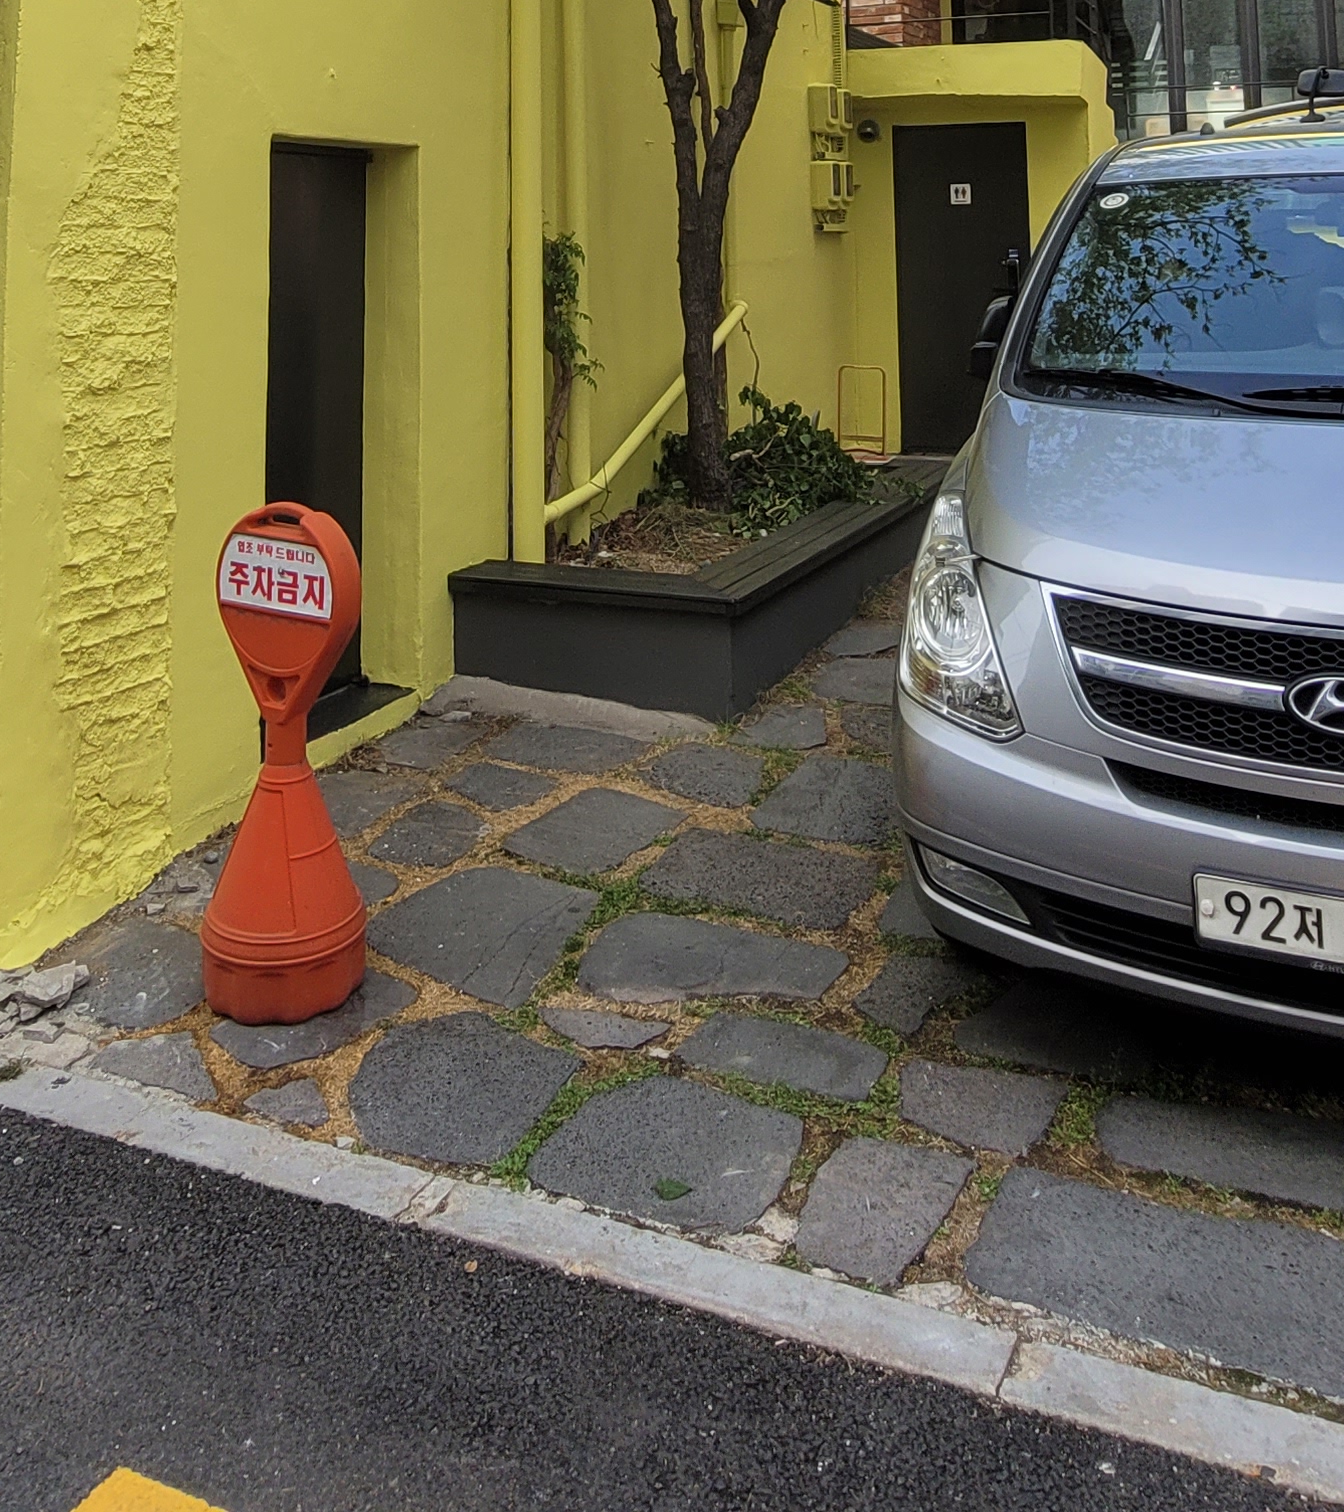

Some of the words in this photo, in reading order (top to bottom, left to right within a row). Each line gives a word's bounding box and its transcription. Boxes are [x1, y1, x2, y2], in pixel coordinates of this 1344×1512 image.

[257, 543, 273, 557] 부탁
[275, 547, 316, 565] 드립니다
[228, 561, 325, 610] 주차금지
[1224, 890, 1325, 950] 92저
